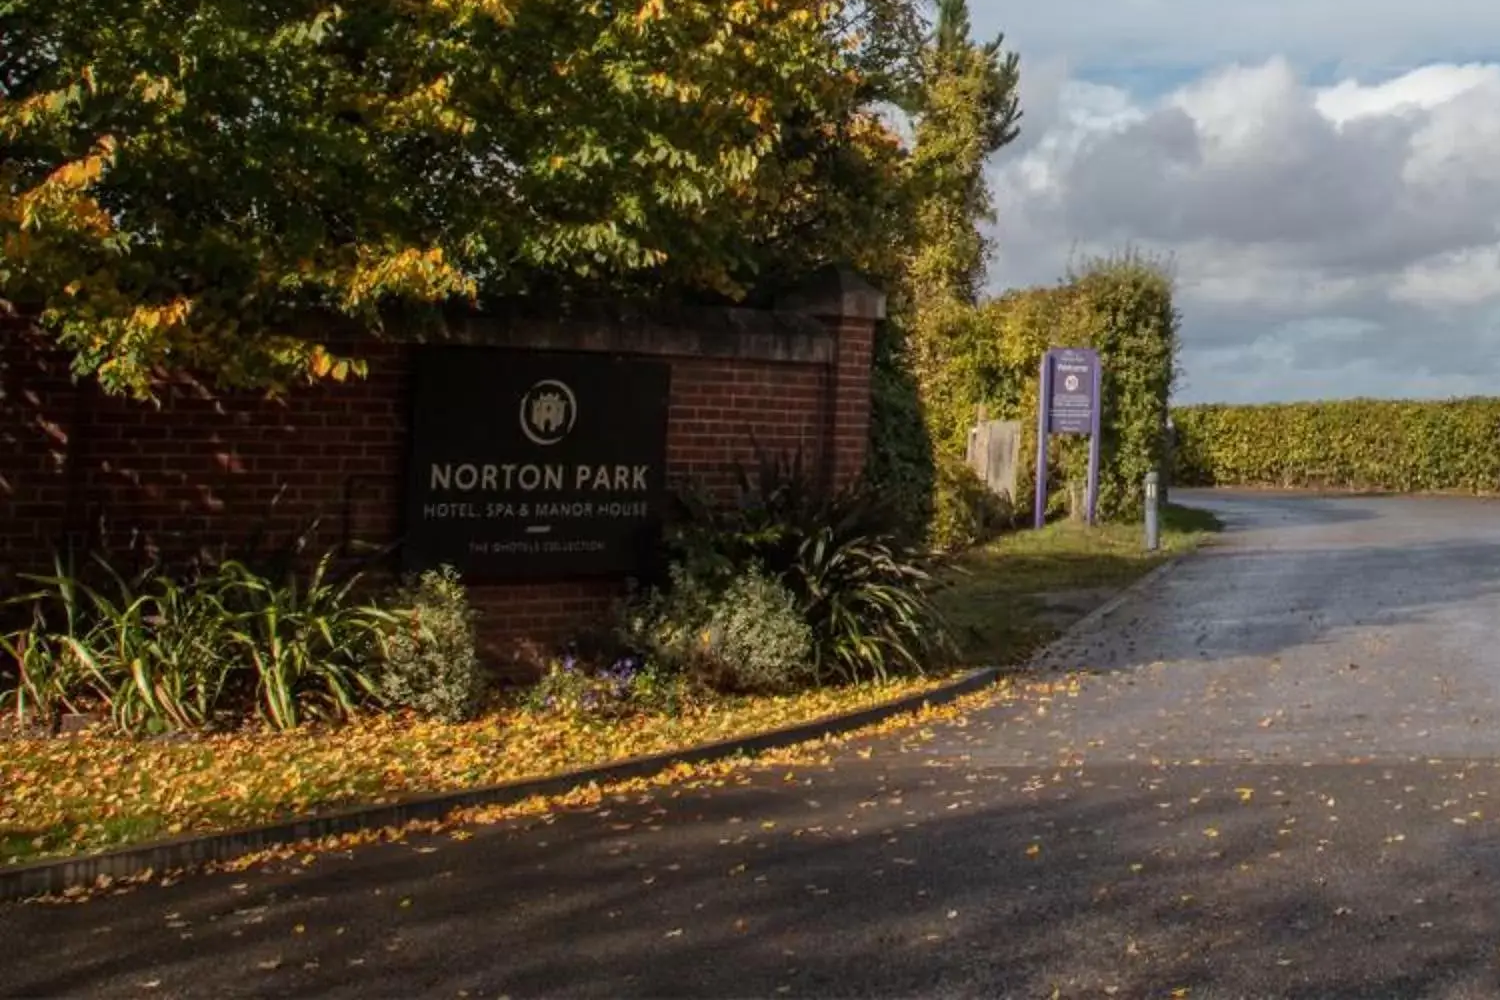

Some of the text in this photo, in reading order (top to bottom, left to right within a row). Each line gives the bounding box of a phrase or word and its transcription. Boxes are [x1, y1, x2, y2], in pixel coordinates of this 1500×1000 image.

[431, 464, 649, 490] NORTON PARK
[486, 504, 515, 518] SPA
[519, 504, 529, 517] &
[536, 503, 592, 517] MANOR
[599, 503, 648, 517] HOUSE
